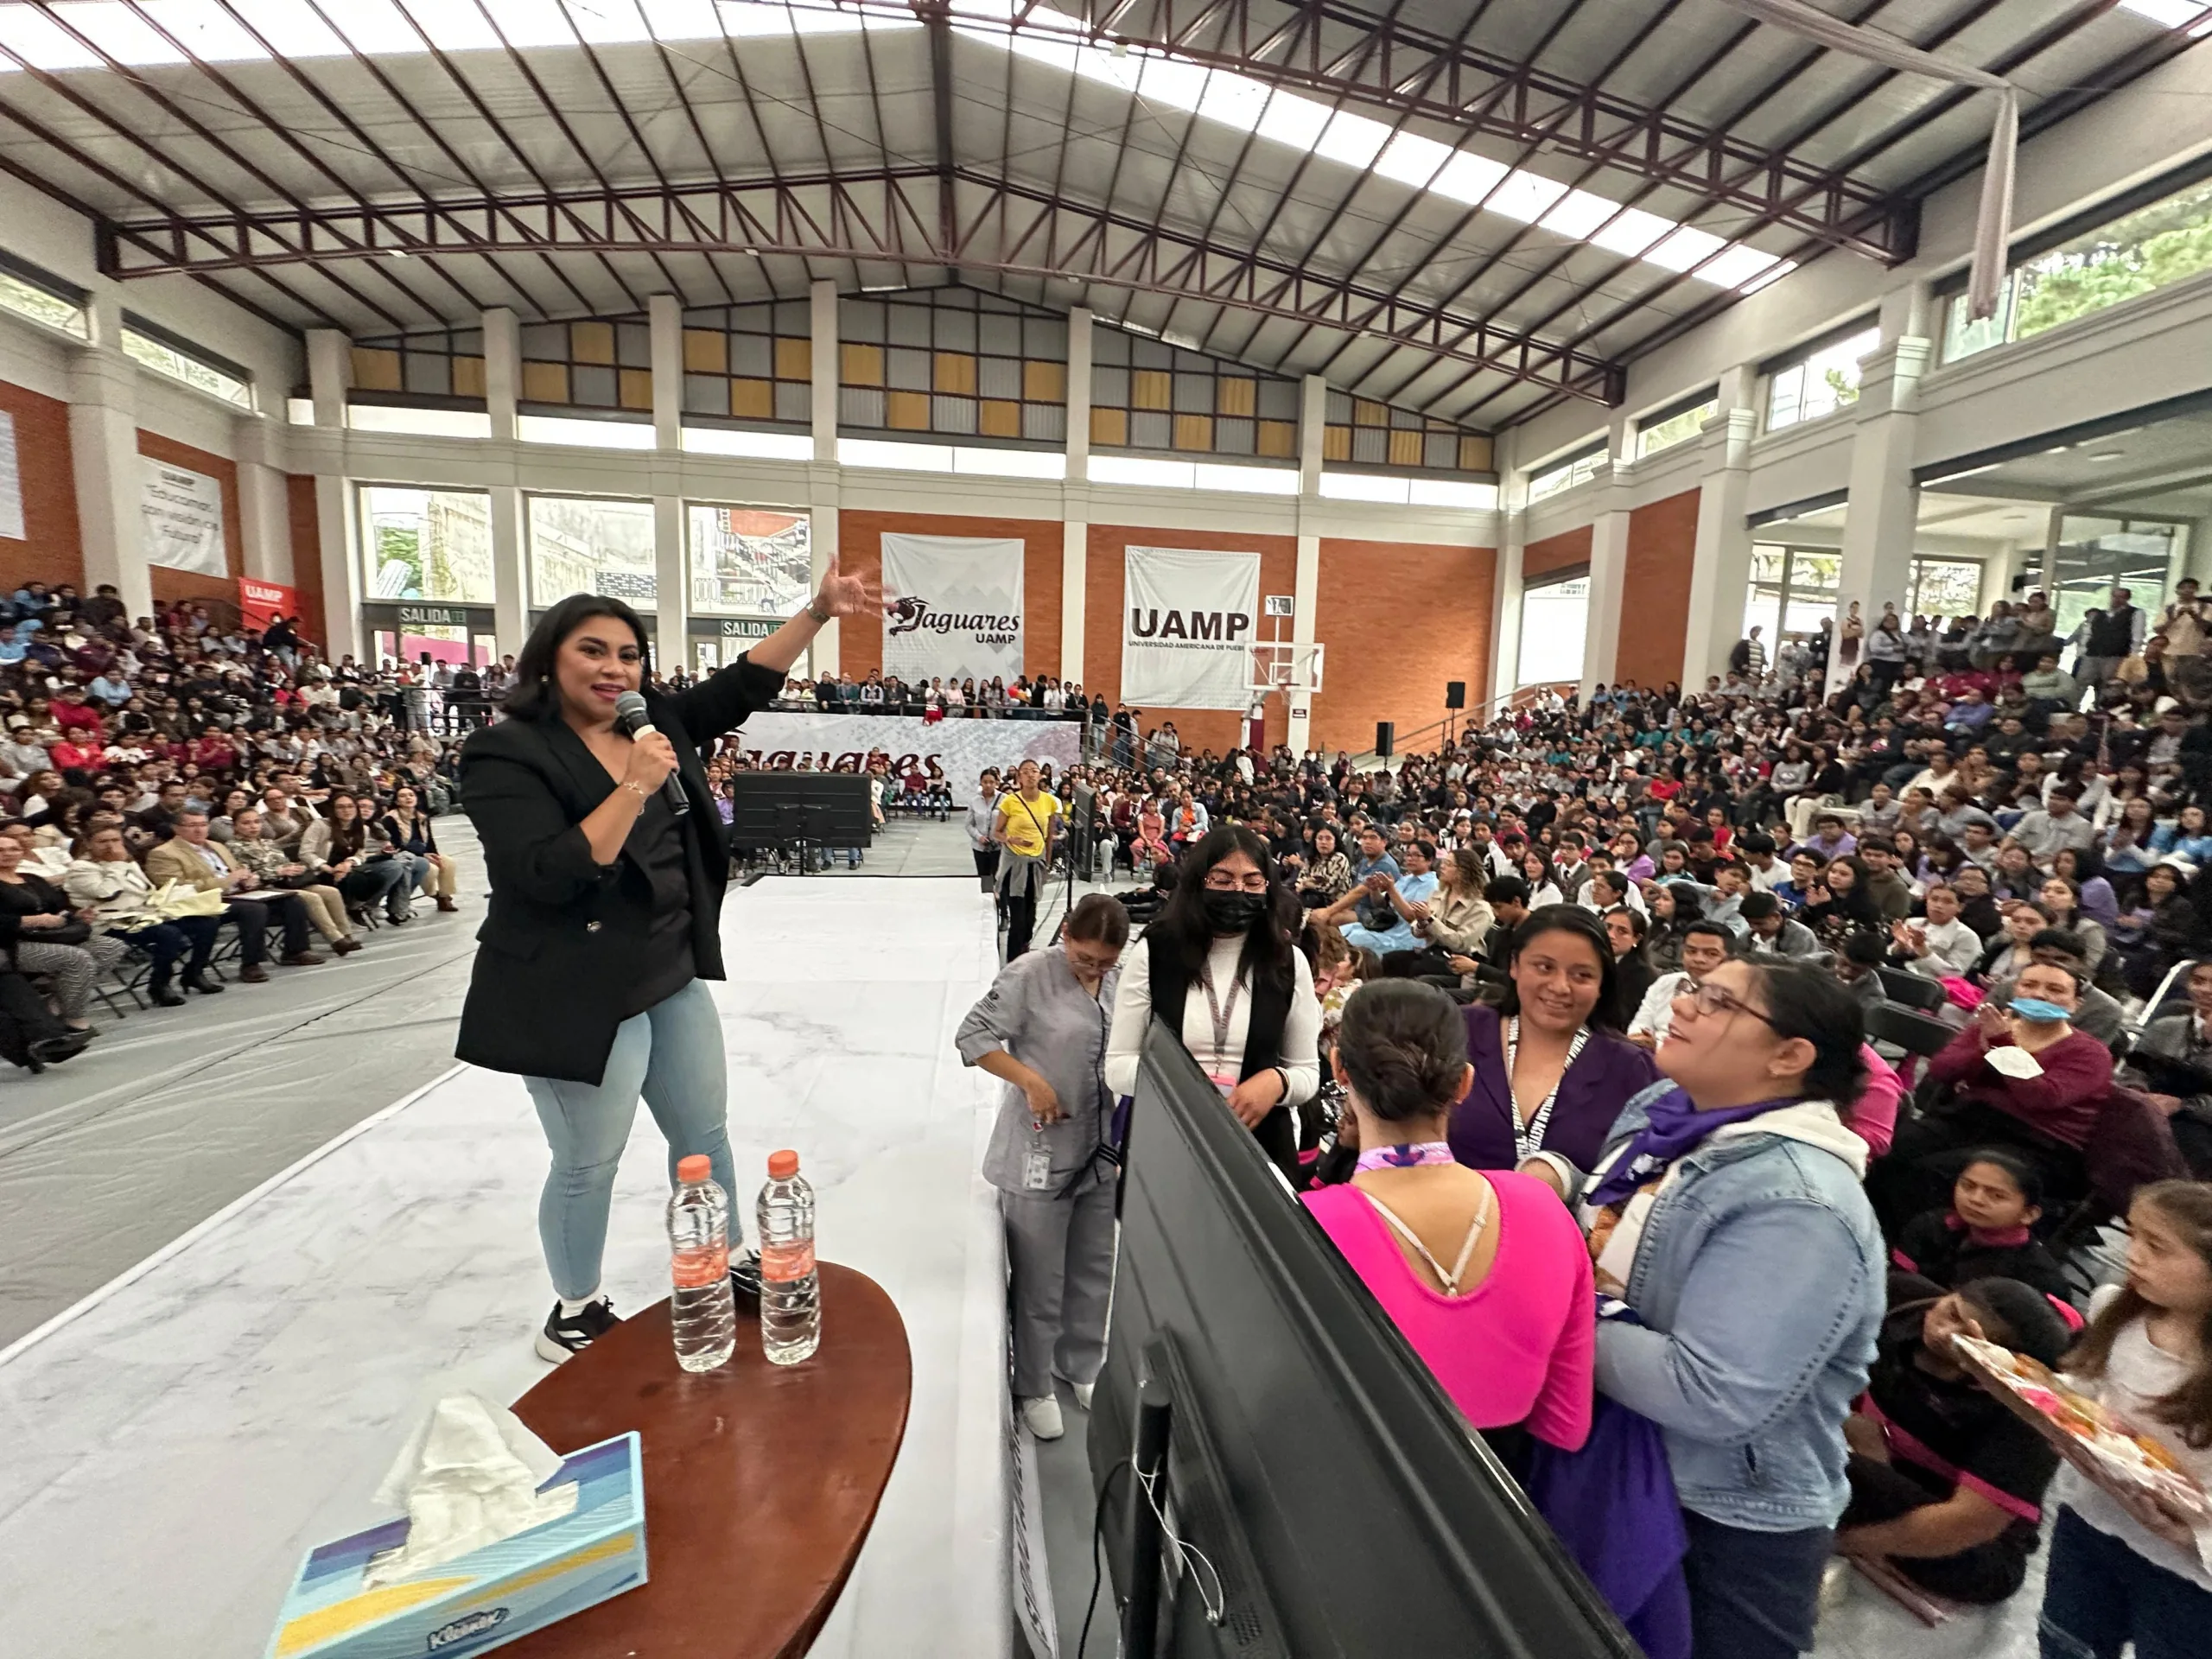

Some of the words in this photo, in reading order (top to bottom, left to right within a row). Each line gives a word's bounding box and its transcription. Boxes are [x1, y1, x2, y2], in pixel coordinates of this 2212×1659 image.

[245, 584, 283, 602] UAMP
[401, 607, 450, 623] SALIDA
[889, 604, 1020, 636] Jaguares
[723, 621, 769, 637] SALIDA
[1131, 607, 1249, 641] UAMP
[976, 633, 1015, 644] UAMP
[1175, 642, 1216, 651] AMERICANA
